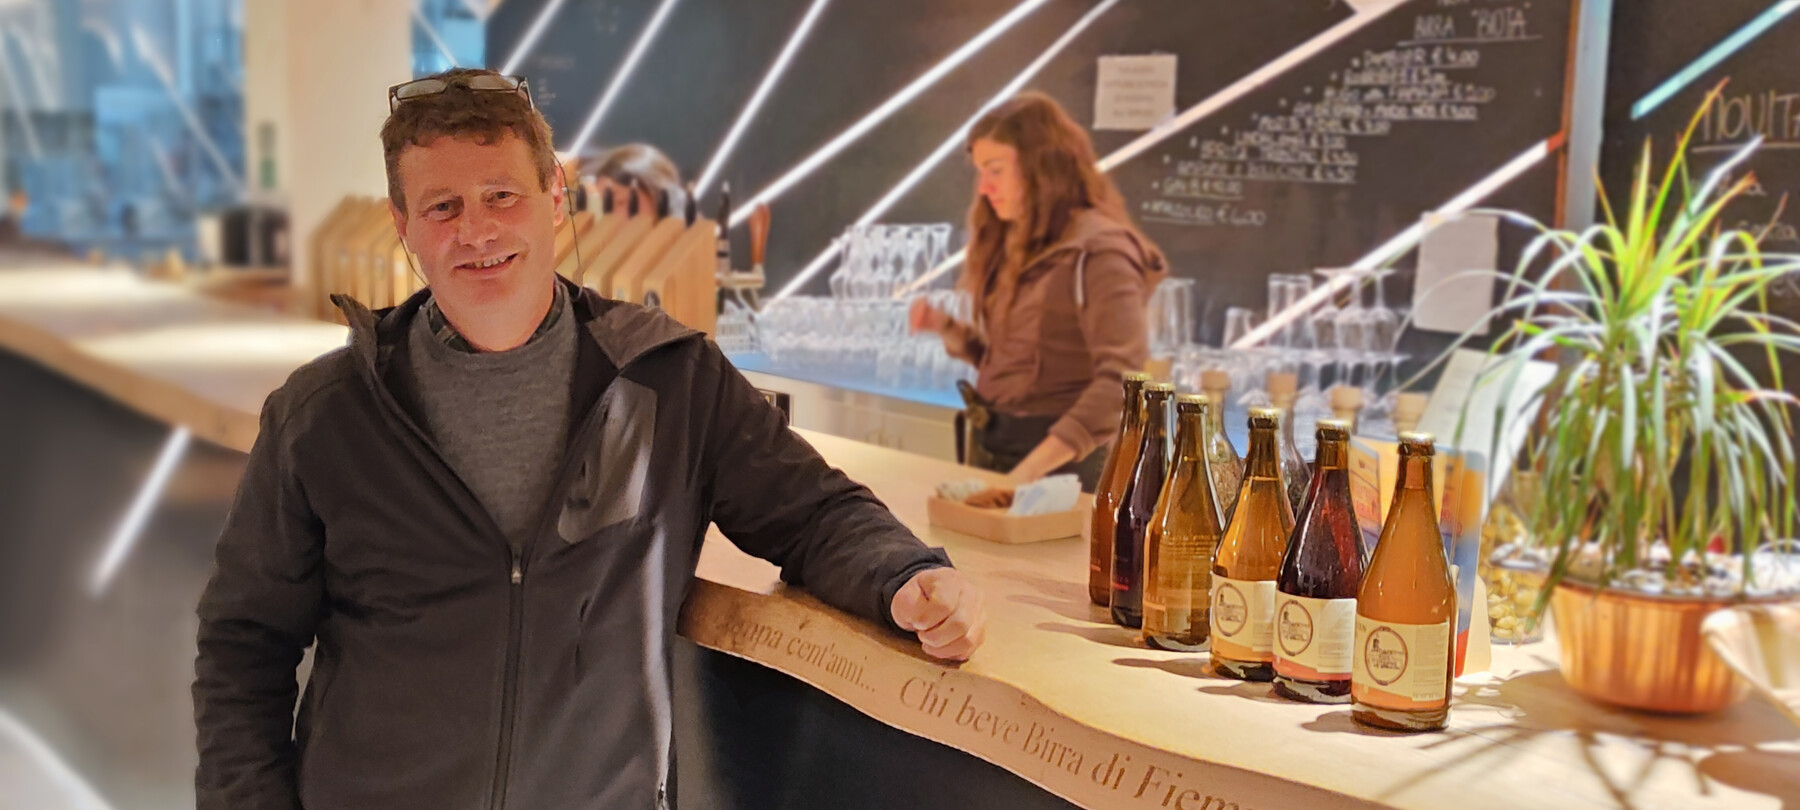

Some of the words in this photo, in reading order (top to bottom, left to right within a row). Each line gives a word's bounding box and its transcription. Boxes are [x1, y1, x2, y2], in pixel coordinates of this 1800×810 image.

[899, 676, 954, 719] Chi
[954, 693, 1021, 744] beve
[1022, 721, 1084, 776] Birra
[1090, 752, 1133, 791] di
